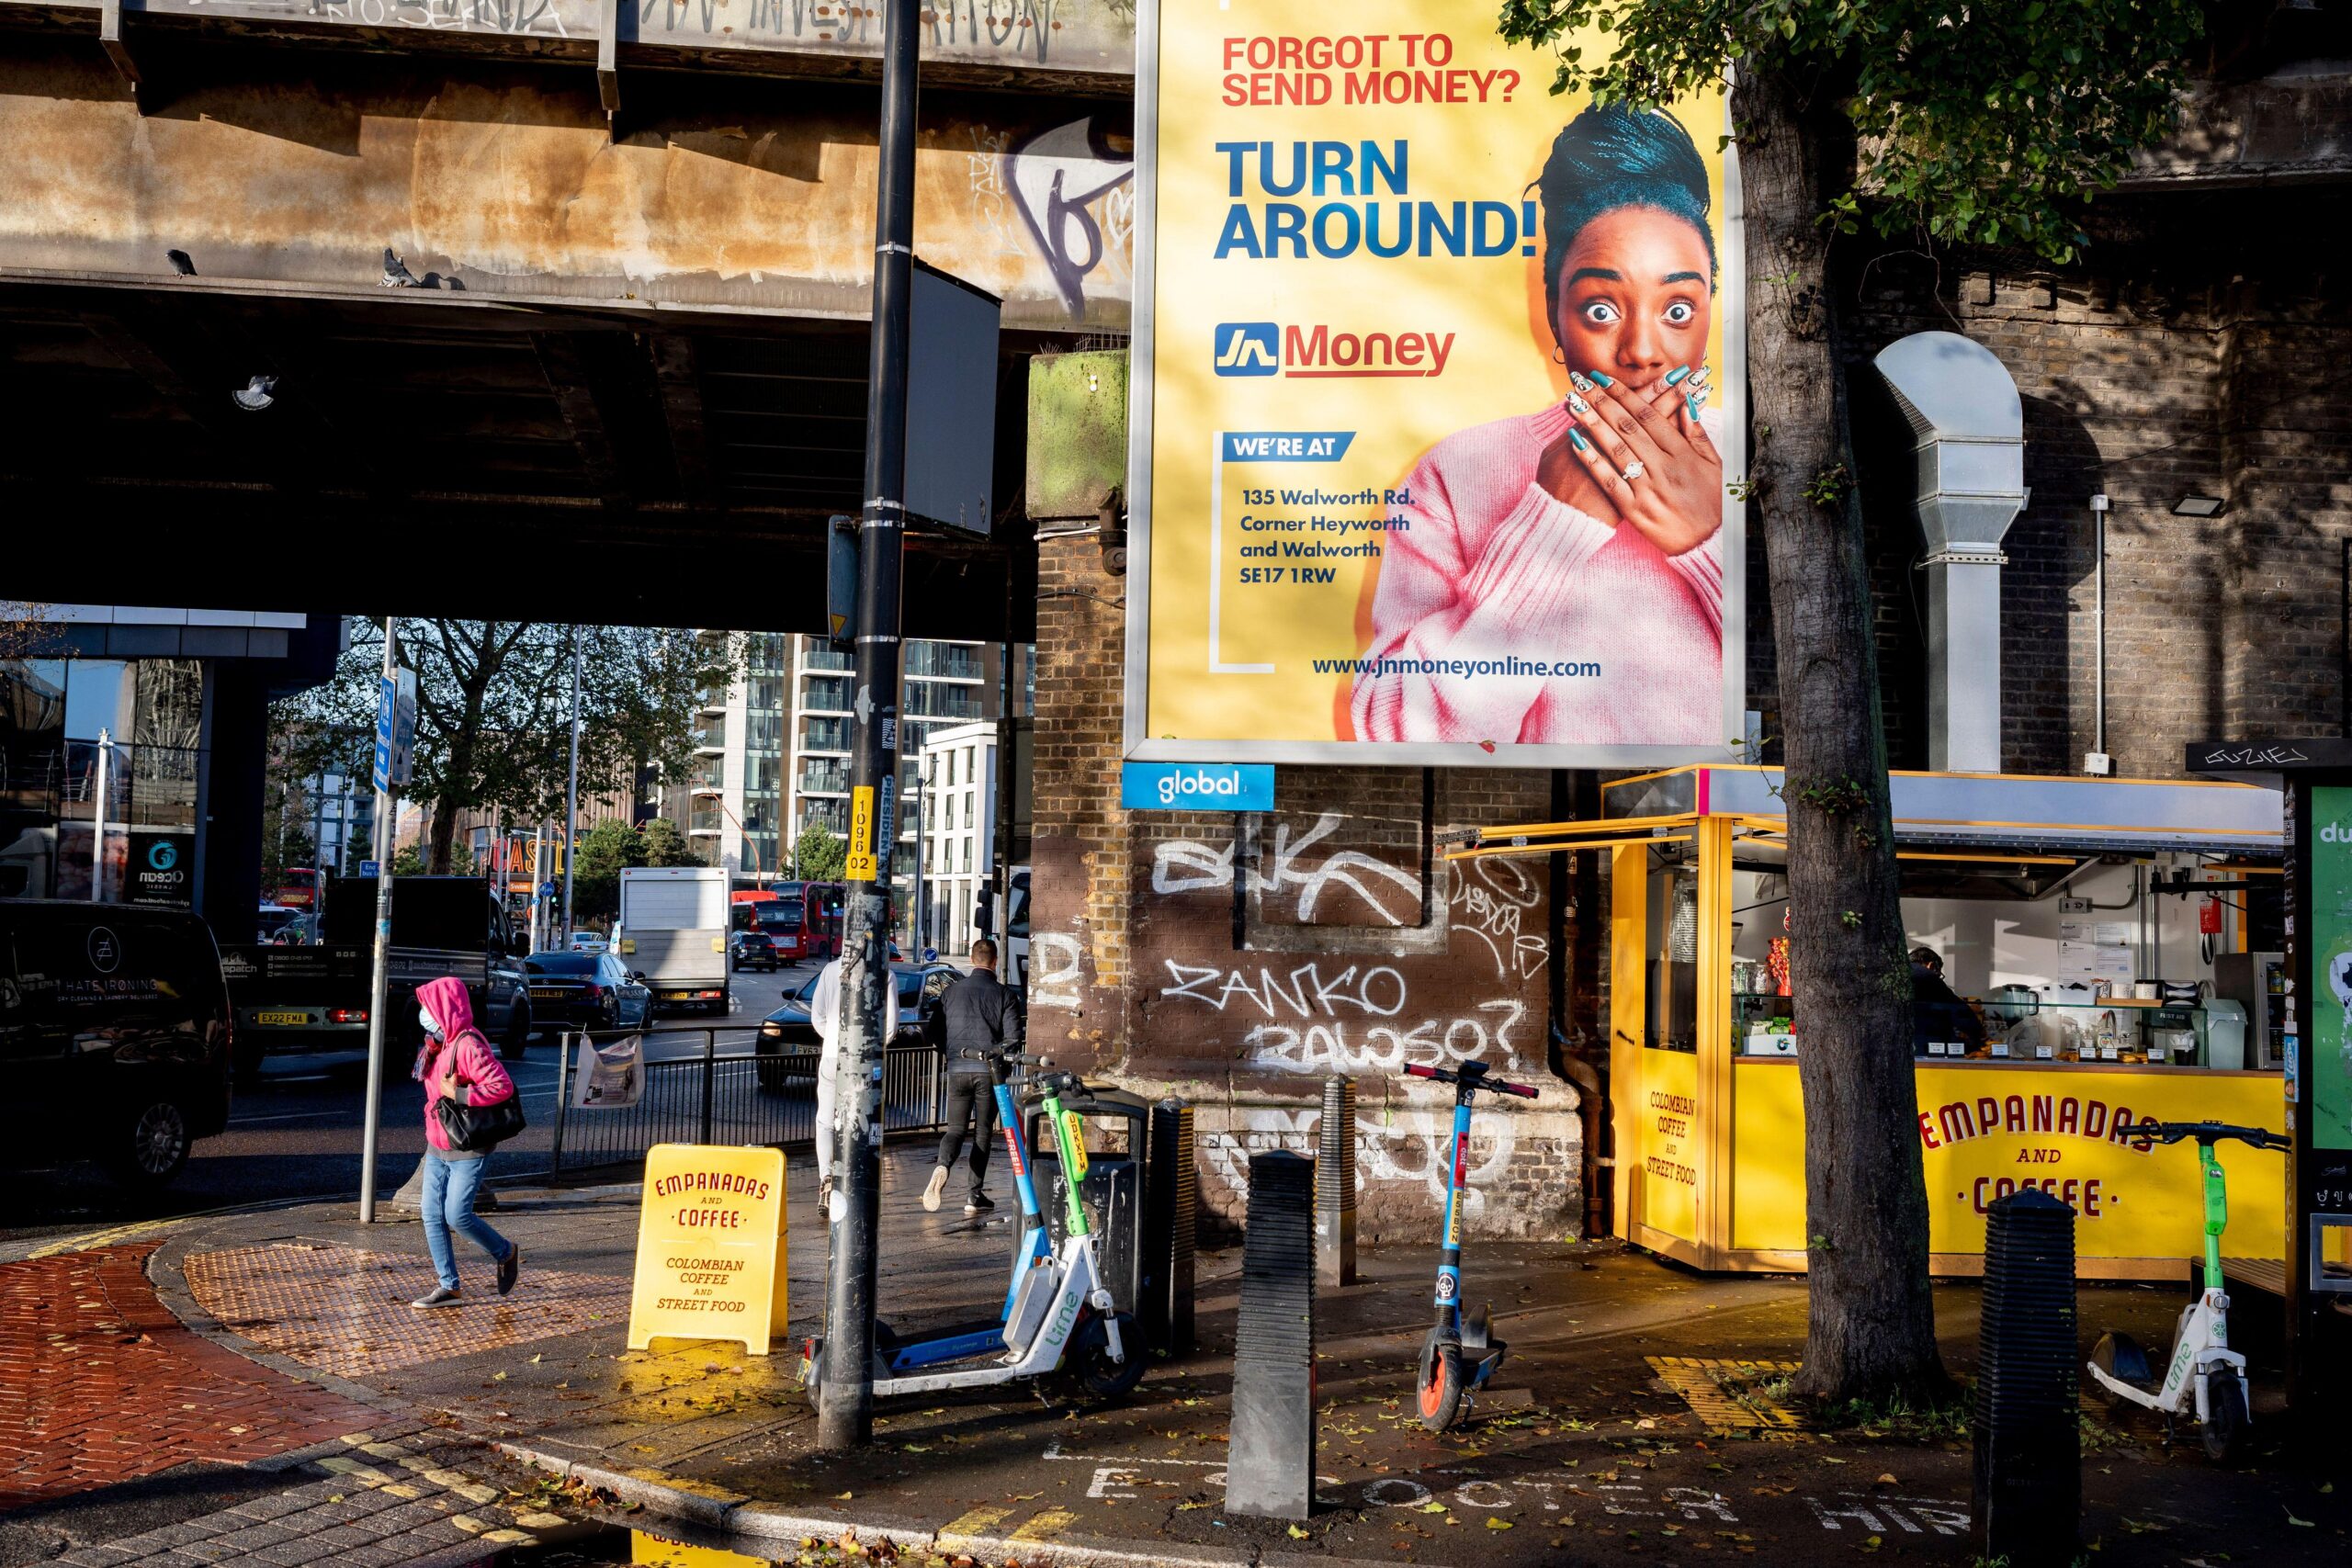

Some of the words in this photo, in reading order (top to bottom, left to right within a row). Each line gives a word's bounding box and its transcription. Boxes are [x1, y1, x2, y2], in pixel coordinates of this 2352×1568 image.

[1223, 35, 1388, 71] FORGOT
[1397, 33, 1453, 67] TO
[1222, 73, 1332, 107] SEND
[1344, 69, 1521, 106] MONEY?
[1215, 140, 1408, 197] TURN
[1213, 201, 1537, 259] AROUND!
[1285, 324, 1456, 378] Money
[1233, 437, 1304, 457] WE'RE
[1307, 437, 1336, 456] AT
[1242, 490, 1275, 505] 135
[1280, 489, 1378, 505] Walworth
[1384, 489, 1415, 505] Rd.
[1240, 516, 1306, 532] Corner
[1310, 514, 1410, 536] Heyworth
[1240, 540, 1278, 558] and
[1282, 540, 1381, 558] Walworth
[1240, 568, 1285, 583] SE17
[1291, 568, 1336, 583] 1RW
[1312, 655, 1601, 680] www.jnmoneyonline.com
[1158, 769, 1239, 804] global
[851, 857, 869, 870] 02
[1160, 959, 1406, 1017] ZANKO
[262, 1013, 284, 1022] EX22
[1650, 1091, 1695, 1116] COLOMBIAN
[1657, 1116, 1686, 1139] COFFEE
[1666, 1143, 1677, 1156] AND
[2016, 1149, 2063, 1164] AND
[1646, 1156, 1675, 1179] STREET
[1675, 1164, 1697, 1186] FOOD
[655, 1172, 770, 1201] EMPANADAS
[678, 1209, 741, 1228] COFFEE
[666, 1258, 744, 1271] COLOMBIAN
[680, 1272, 729, 1285] COFFEE
[693, 1288, 713, 1296] AND
[657, 1298, 708, 1312] STREET
[709, 1301, 745, 1313] FOOD
